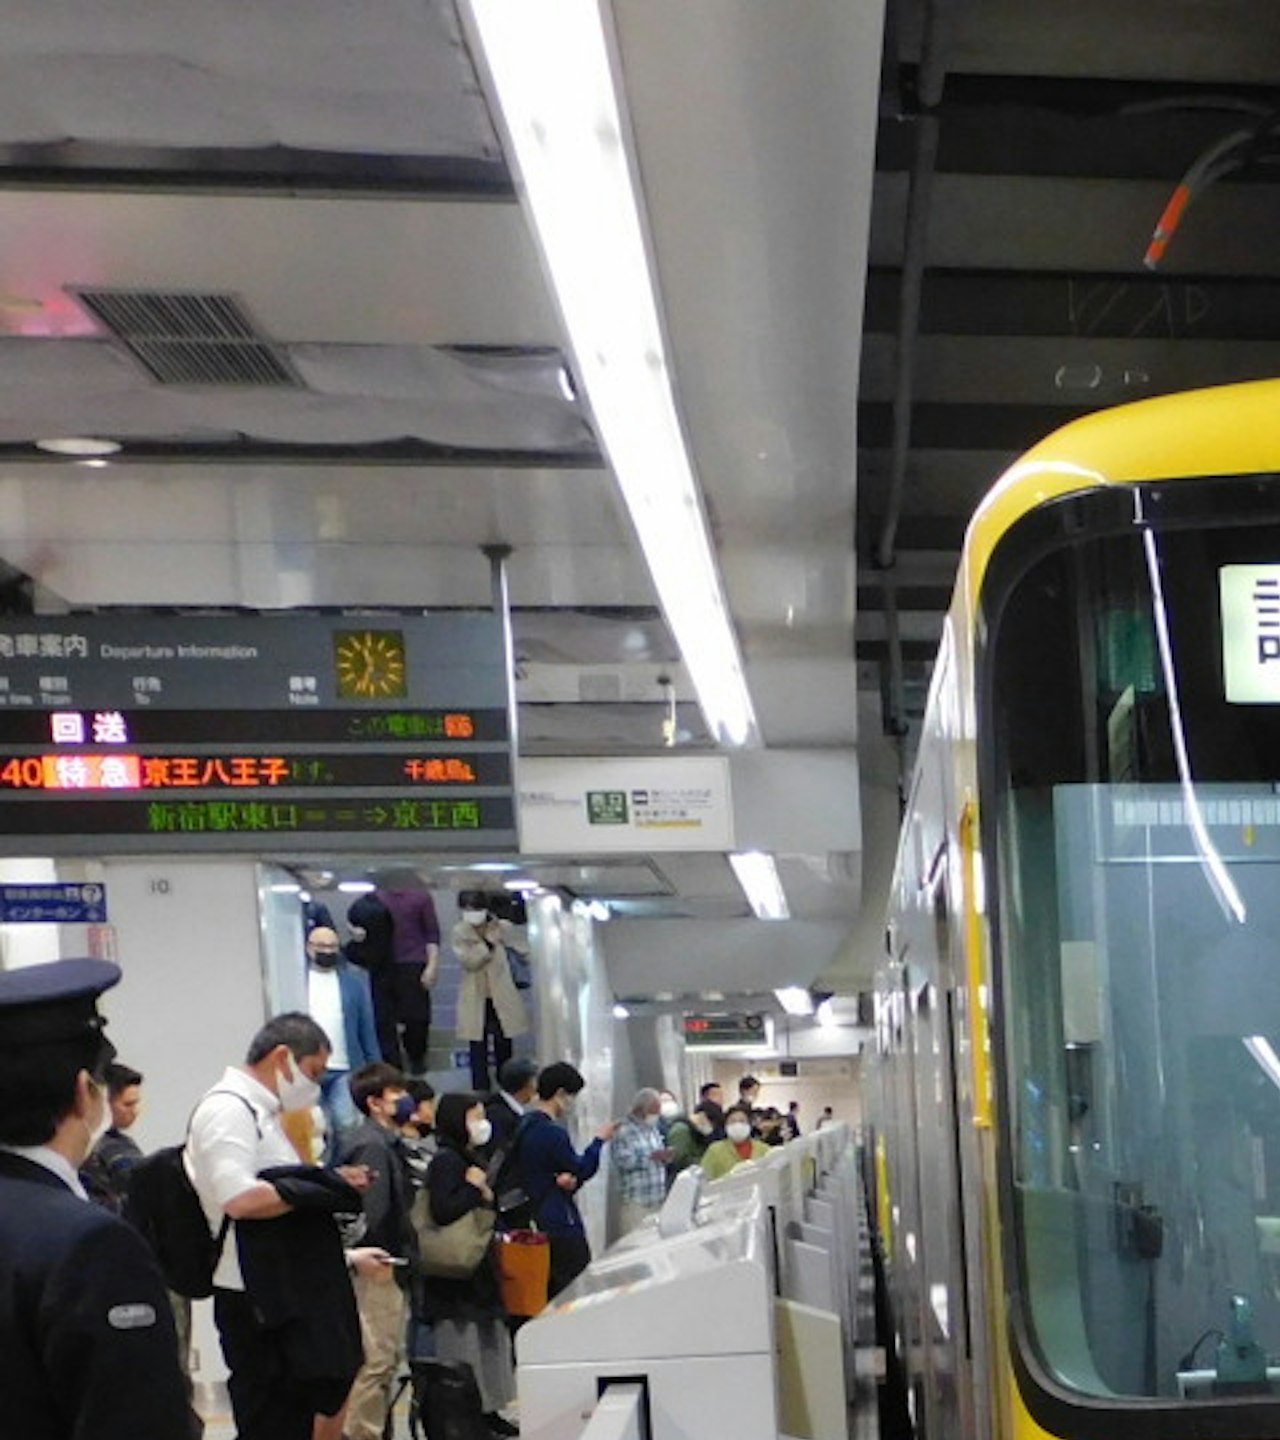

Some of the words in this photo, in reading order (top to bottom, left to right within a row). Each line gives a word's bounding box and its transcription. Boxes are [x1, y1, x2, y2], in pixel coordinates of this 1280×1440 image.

[101, 643, 174, 661] Departure
[177, 643, 258, 659] Information
[51, 712, 128, 744] 回送
[1, 758, 42, 788] 40
[56, 757, 129, 789] 特急
[142, 757, 289, 787] 京王八王子
[149, 803, 298, 832] 新宿駅東口
[394, 801, 480, 829] 京王西
